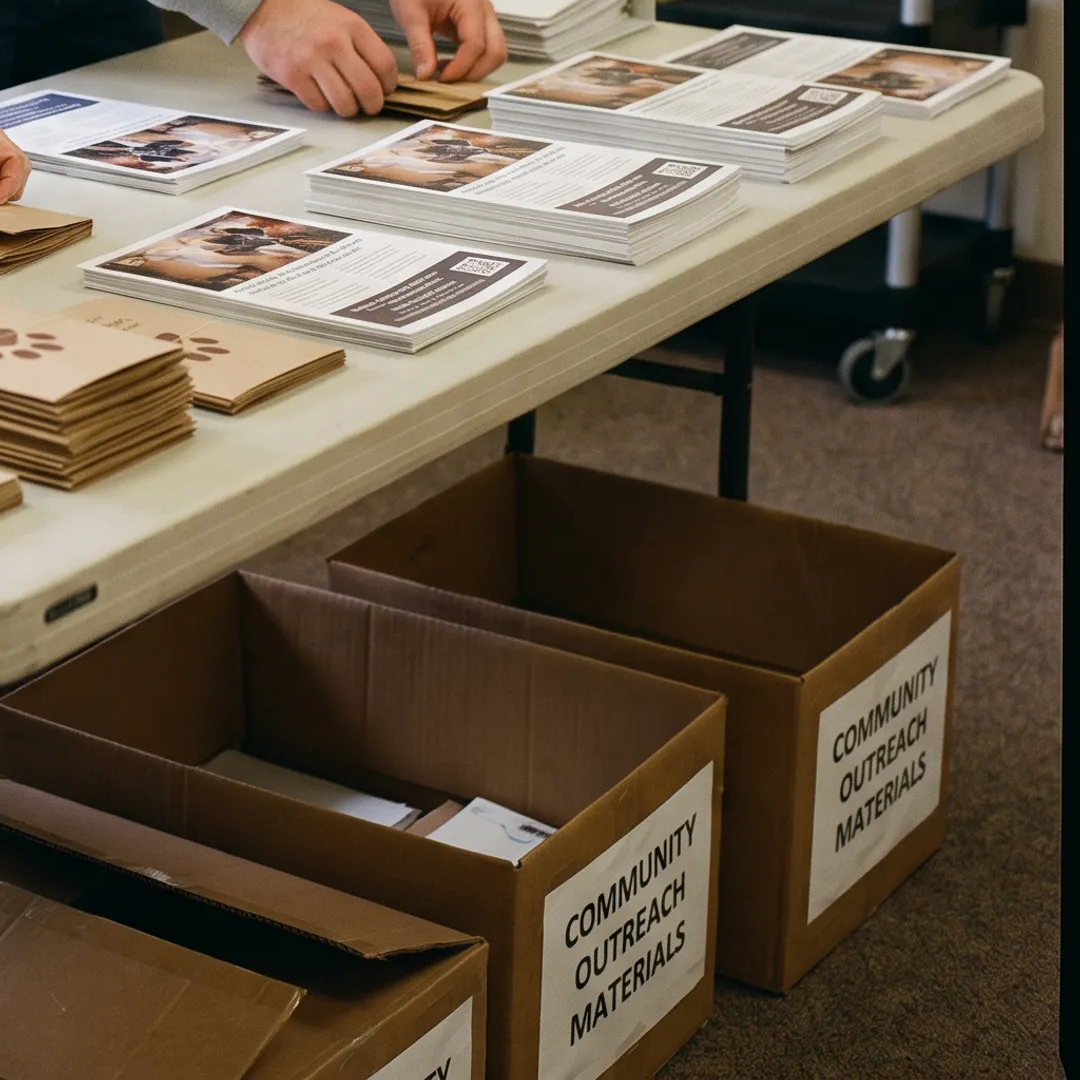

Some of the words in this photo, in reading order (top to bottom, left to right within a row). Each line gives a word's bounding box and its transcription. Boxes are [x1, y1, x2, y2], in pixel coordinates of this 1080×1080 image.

[833, 655, 938, 764] COMMUNITY
[840, 707, 928, 803] OUTREACH
[835, 751, 926, 852] MATERIALS
[565, 812, 697, 948] COMMUNITY
[575, 871, 685, 990] OUTREACH
[570, 920, 685, 1046] MATERIALS
